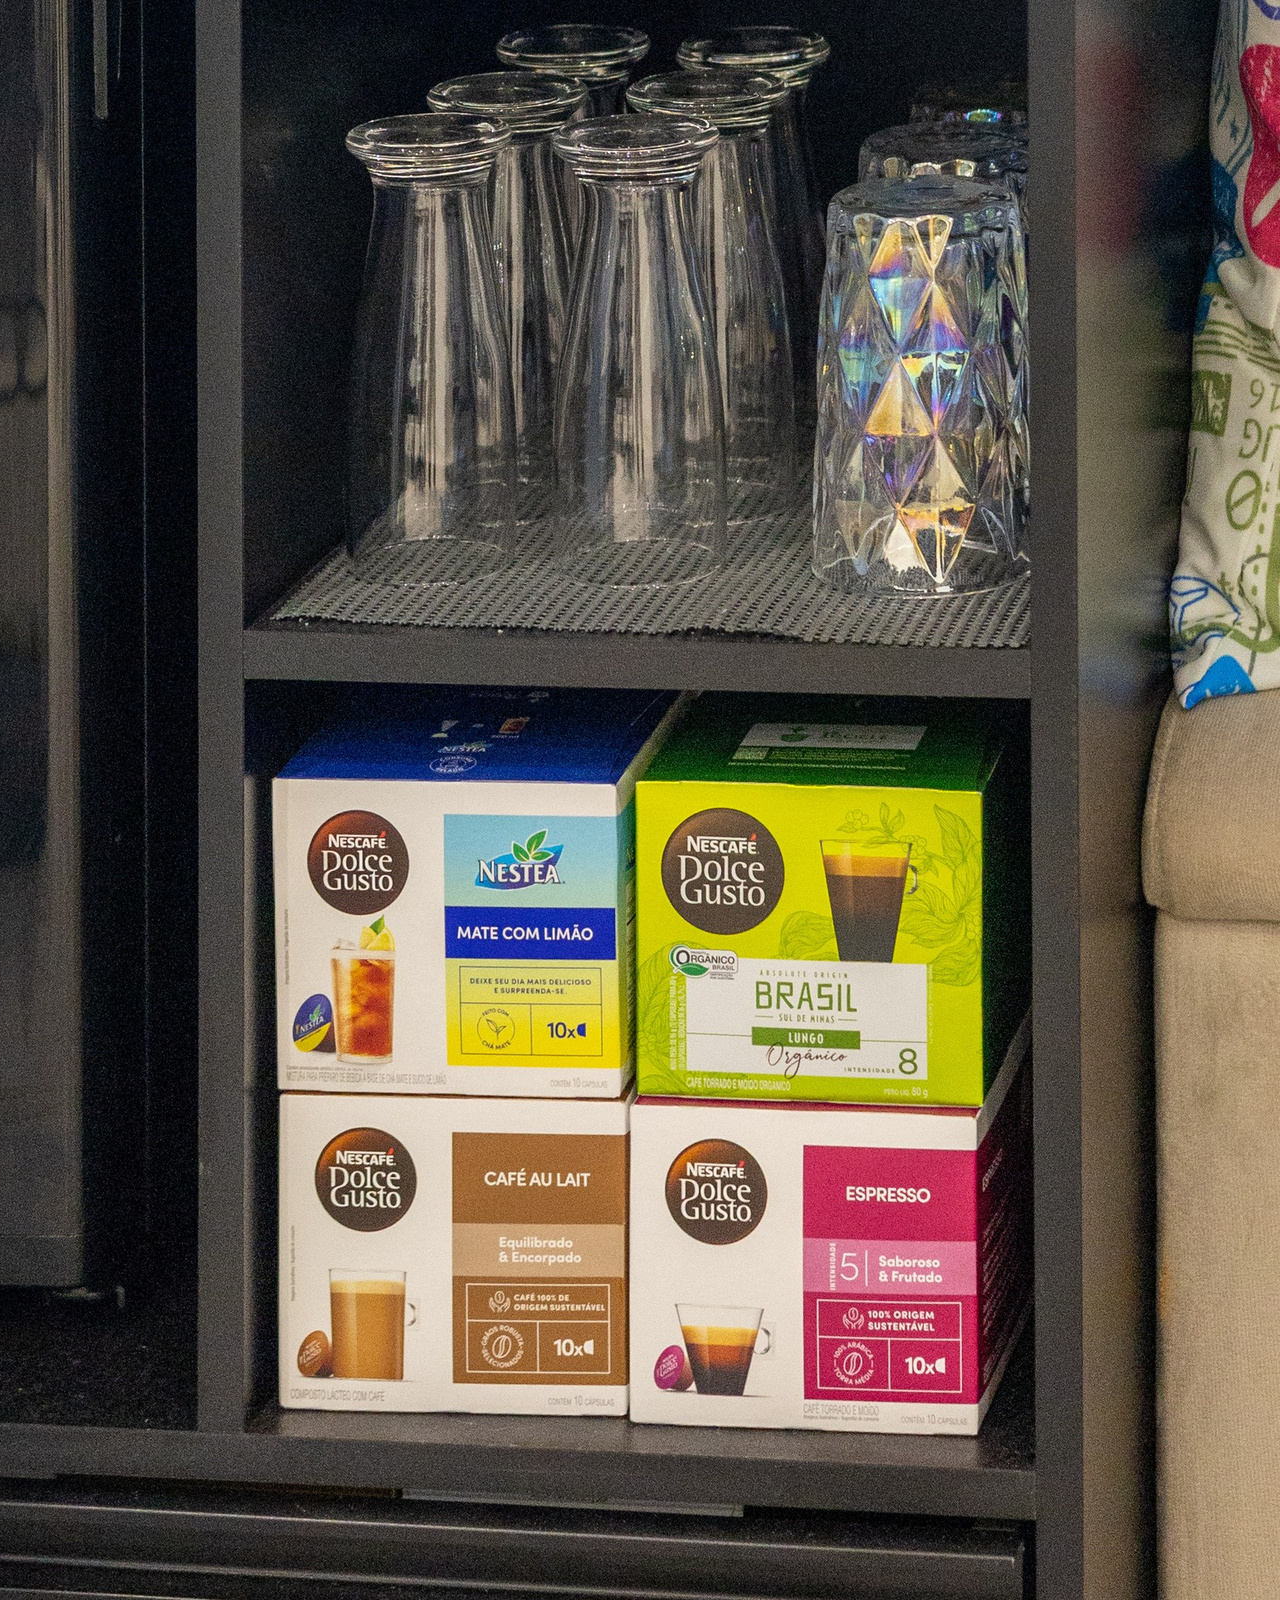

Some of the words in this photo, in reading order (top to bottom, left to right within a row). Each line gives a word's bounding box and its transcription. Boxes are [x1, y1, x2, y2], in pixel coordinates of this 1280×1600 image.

[328, 830, 388, 849] NESCAFÉ
[686, 833, 759, 855] NESCAFÉ
[322, 850, 393, 873] Dolce
[678, 854, 765, 883] Dolce
[323, 869, 394, 892] Gusto
[477, 859, 566, 885] NESTEA
[680, 878, 766, 907] Gusto
[457, 926, 499, 940] MATE
[502, 927, 540, 941] COM
[544, 924, 594, 941] LIMÃO
[676, 949, 735, 965] ORGÂNICO
[527, 978, 547, 986] MAIS
[759, 969, 807, 978] ABSOLUTE
[814, 971, 848, 979] ORIGIN
[755, 980, 858, 1012] BRASIL
[482, 1008, 497, 1017] FEITO
[496, 1008, 510, 1017] COM
[778, 1013, 793, 1022] SUL
[796, 1014, 806, 1022] DE
[810, 1015, 835, 1024] MINAS
[547, 1022, 576, 1039] 10x
[788, 1032, 824, 1044] LUNGO
[481, 1039, 495, 1050] CHÁ
[495, 1040, 512, 1050] MATE
[766, 1041, 848, 1080] Orgânico
[898, 1048, 919, 1075] 8
[572, 1077, 581, 1089] 10
[703, 1078, 732, 1089] TORRADO
[911, 1087, 921, 1096] 80
[336, 1148, 396, 1166] NESCAFÉ
[328, 1166, 401, 1190] Dolce
[484, 1168, 526, 1187] CAFÉ
[529, 1172, 552, 1187] AU
[556, 1173, 591, 1188] LAIT
[686, 1160, 747, 1179] NESCAFÉ
[330, 1185, 402, 1209] Gusto
[678, 1178, 751, 1203] Dolce
[846, 1186, 931, 1204] ESPRESSO
[680, 1198, 752, 1222] Gusto
[499, 1236, 574, 1253] Equilibrado
[499, 1251, 509, 1263] &
[511, 1251, 582, 1267] Encorpado
[840, 1252, 859, 1281] 5
[878, 1255, 940, 1268] Saboroso
[878, 1271, 888, 1282] &
[891, 1271, 943, 1283] Frutado
[513, 1292, 535, 1302] CAFÉ
[537, 1294, 557, 1302] 100%
[558, 1294, 570, 1302] DE
[549, 1302, 606, 1312] SUSTENTÁVEL
[868, 1310, 891, 1319] 100%
[893, 1311, 935, 1320] ORIGEM
[867, 1321, 935, 1331] SUSTENTÁVEL
[481, 1325, 499, 1346] GRÃOS
[498, 1324, 525, 1347] ROBUSTA
[553, 1338, 584, 1356] 10x
[833, 1344, 847, 1360] 100%
[847, 1341, 874, 1360] ARÁBICA
[481, 1349, 525, 1369] SELECIONADOS
[904, 1357, 936, 1375] 10x
[833, 1367, 854, 1386] TORRA
[854, 1368, 875, 1386] MÉDIA
[290, 1388, 326, 1400] COMPOSTO
[352, 1390, 368, 1401] COM
[574, 1395, 584, 1406] 10
[803, 1403, 820, 1414] CAFÉ
[821, 1404, 852, 1415] TORRADO
[858, 1404, 880, 1416] MOÍDO
[927, 1414, 937, 1424] 10
